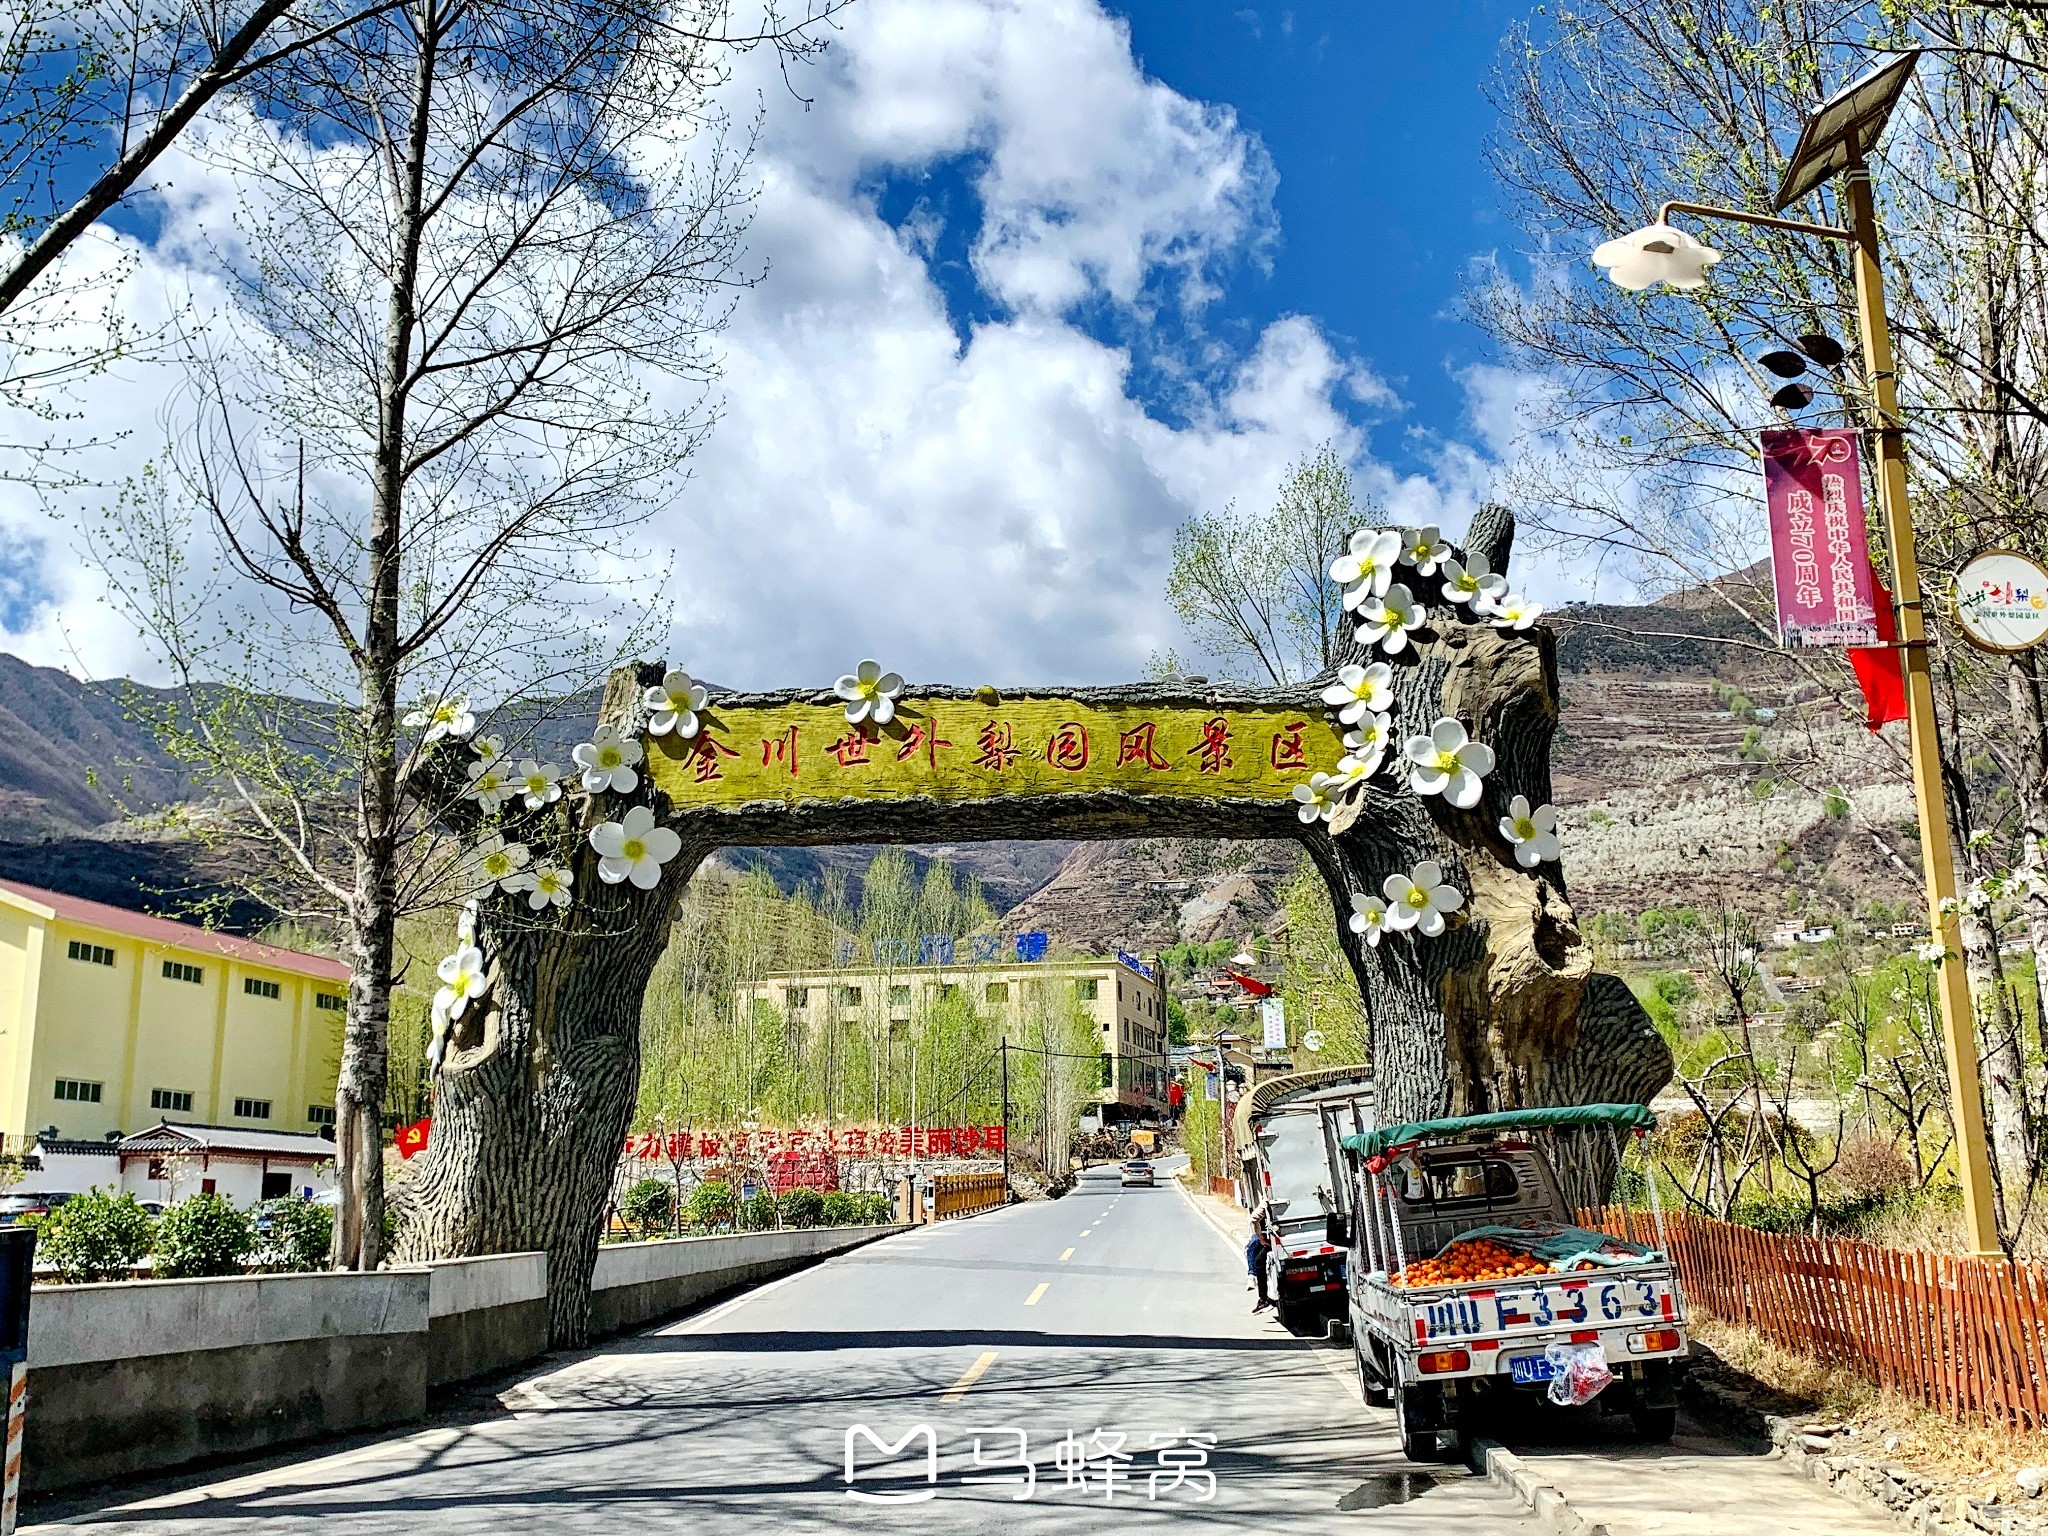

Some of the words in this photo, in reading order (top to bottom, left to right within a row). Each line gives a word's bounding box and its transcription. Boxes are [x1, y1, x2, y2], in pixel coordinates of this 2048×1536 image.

[1788, 490, 1823, 608] 成立70周年
[1822, 474, 1857, 623] 热烈庆祝中华人民共和国
[682, 716, 1309, 783] 金川世外梨园风景区
